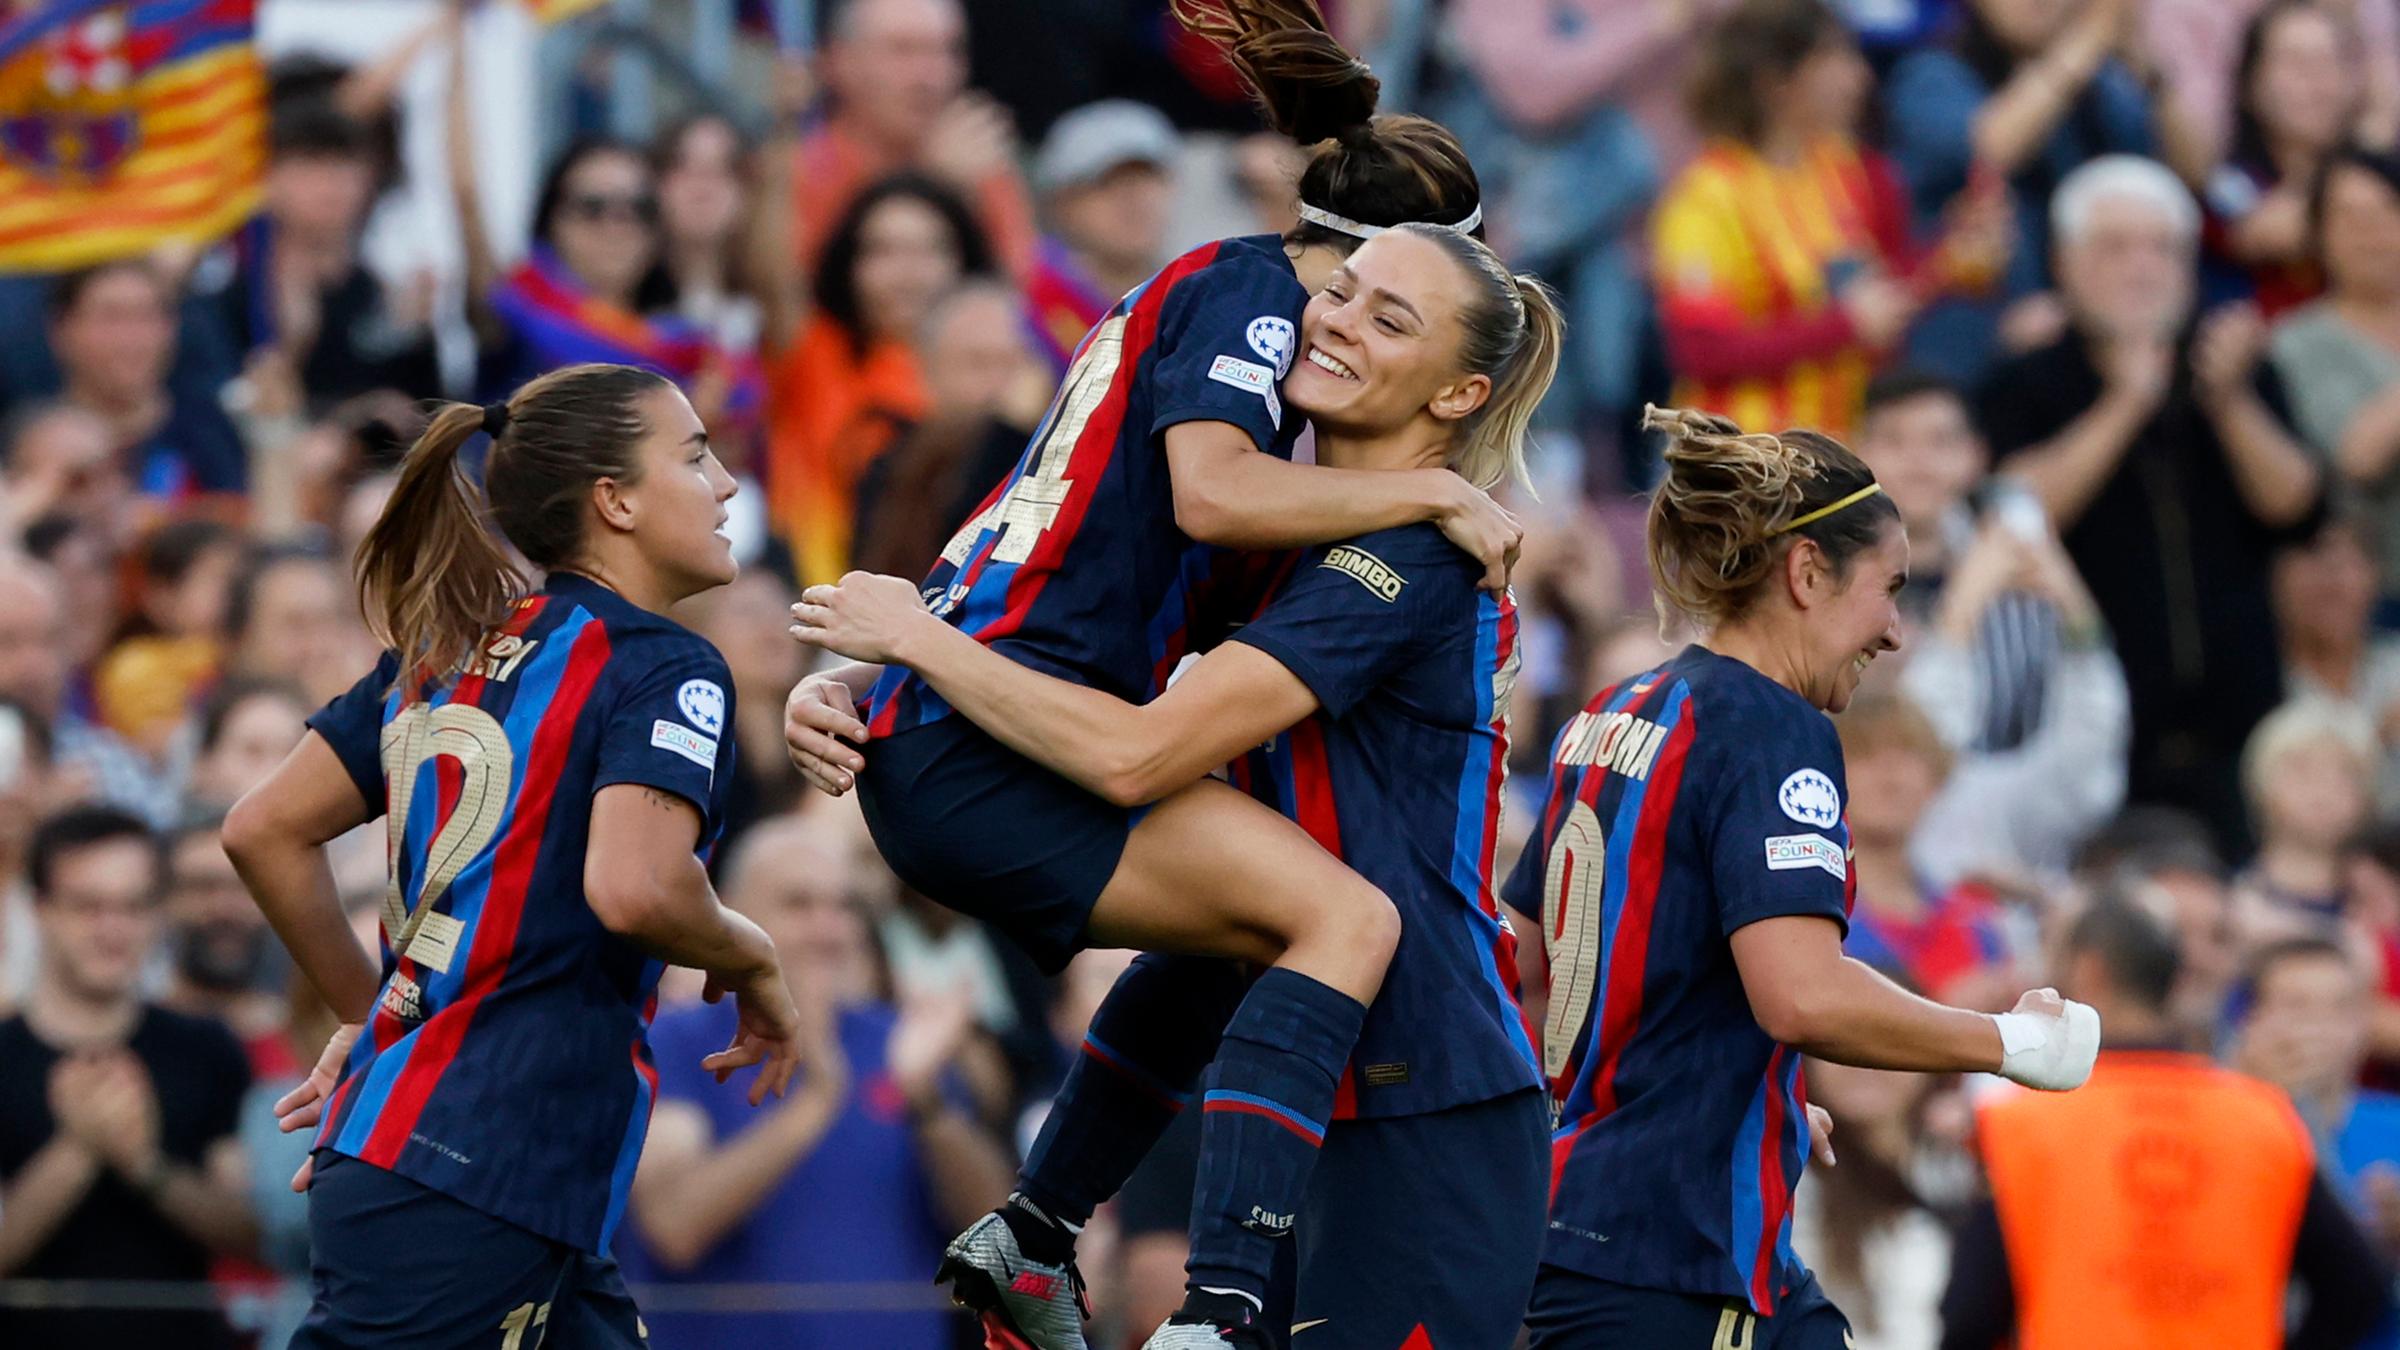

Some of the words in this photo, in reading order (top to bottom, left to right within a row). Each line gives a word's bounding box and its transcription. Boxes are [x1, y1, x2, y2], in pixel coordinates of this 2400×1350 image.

[1323, 548, 1402, 599] BIMBO
[379, 701, 513, 974] 12
[1768, 843, 1844, 866] FOUNDTIO
[1543, 799, 1606, 1079] 9
[499, 1302, 551, 1350] 1
